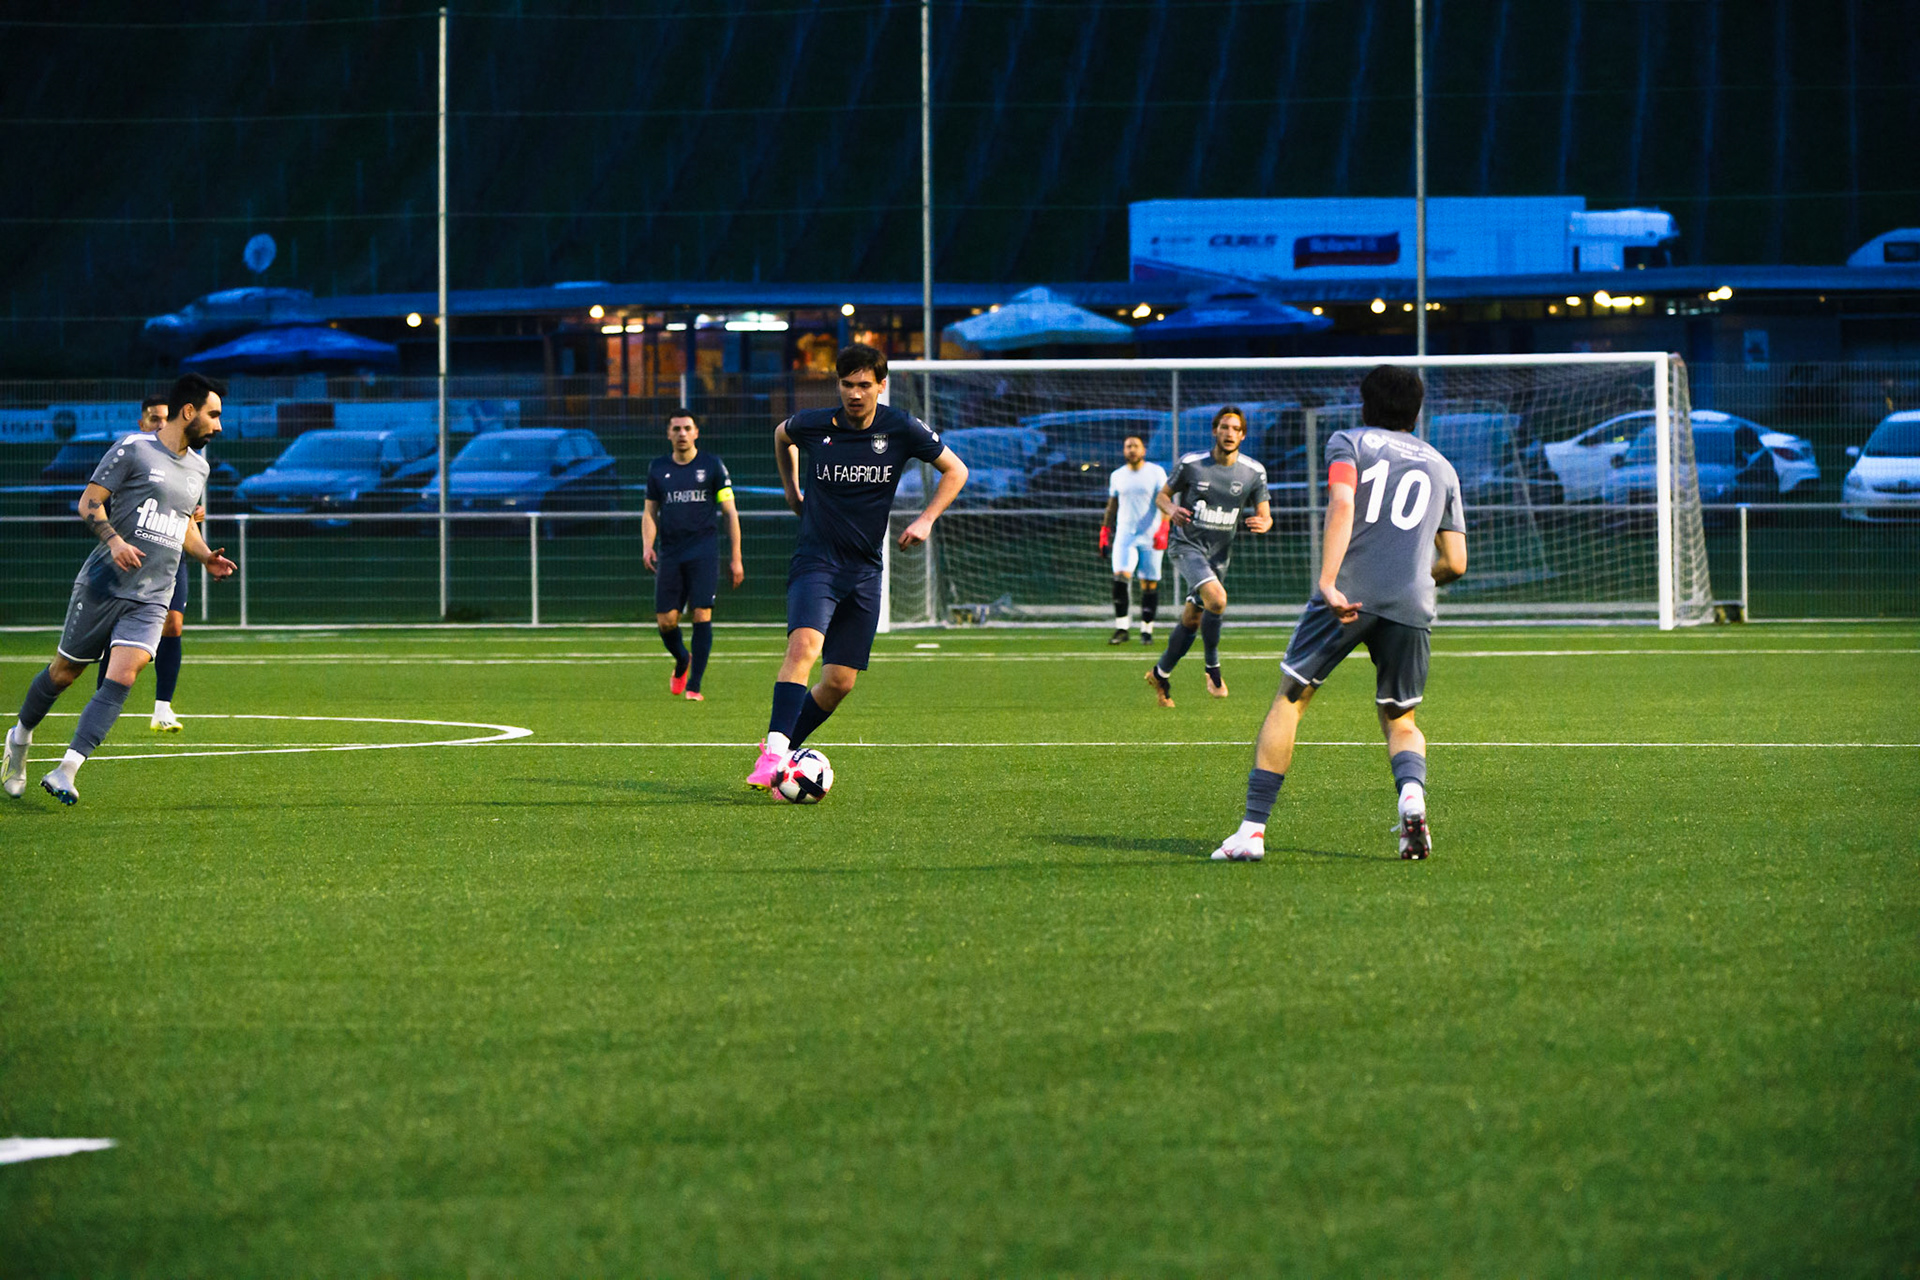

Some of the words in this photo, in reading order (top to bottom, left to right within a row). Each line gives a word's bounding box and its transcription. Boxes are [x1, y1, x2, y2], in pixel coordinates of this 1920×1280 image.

[816, 463, 831, 481] LA
[834, 464, 893, 484] FABRIQUE
[1361, 459, 1432, 531] 10
